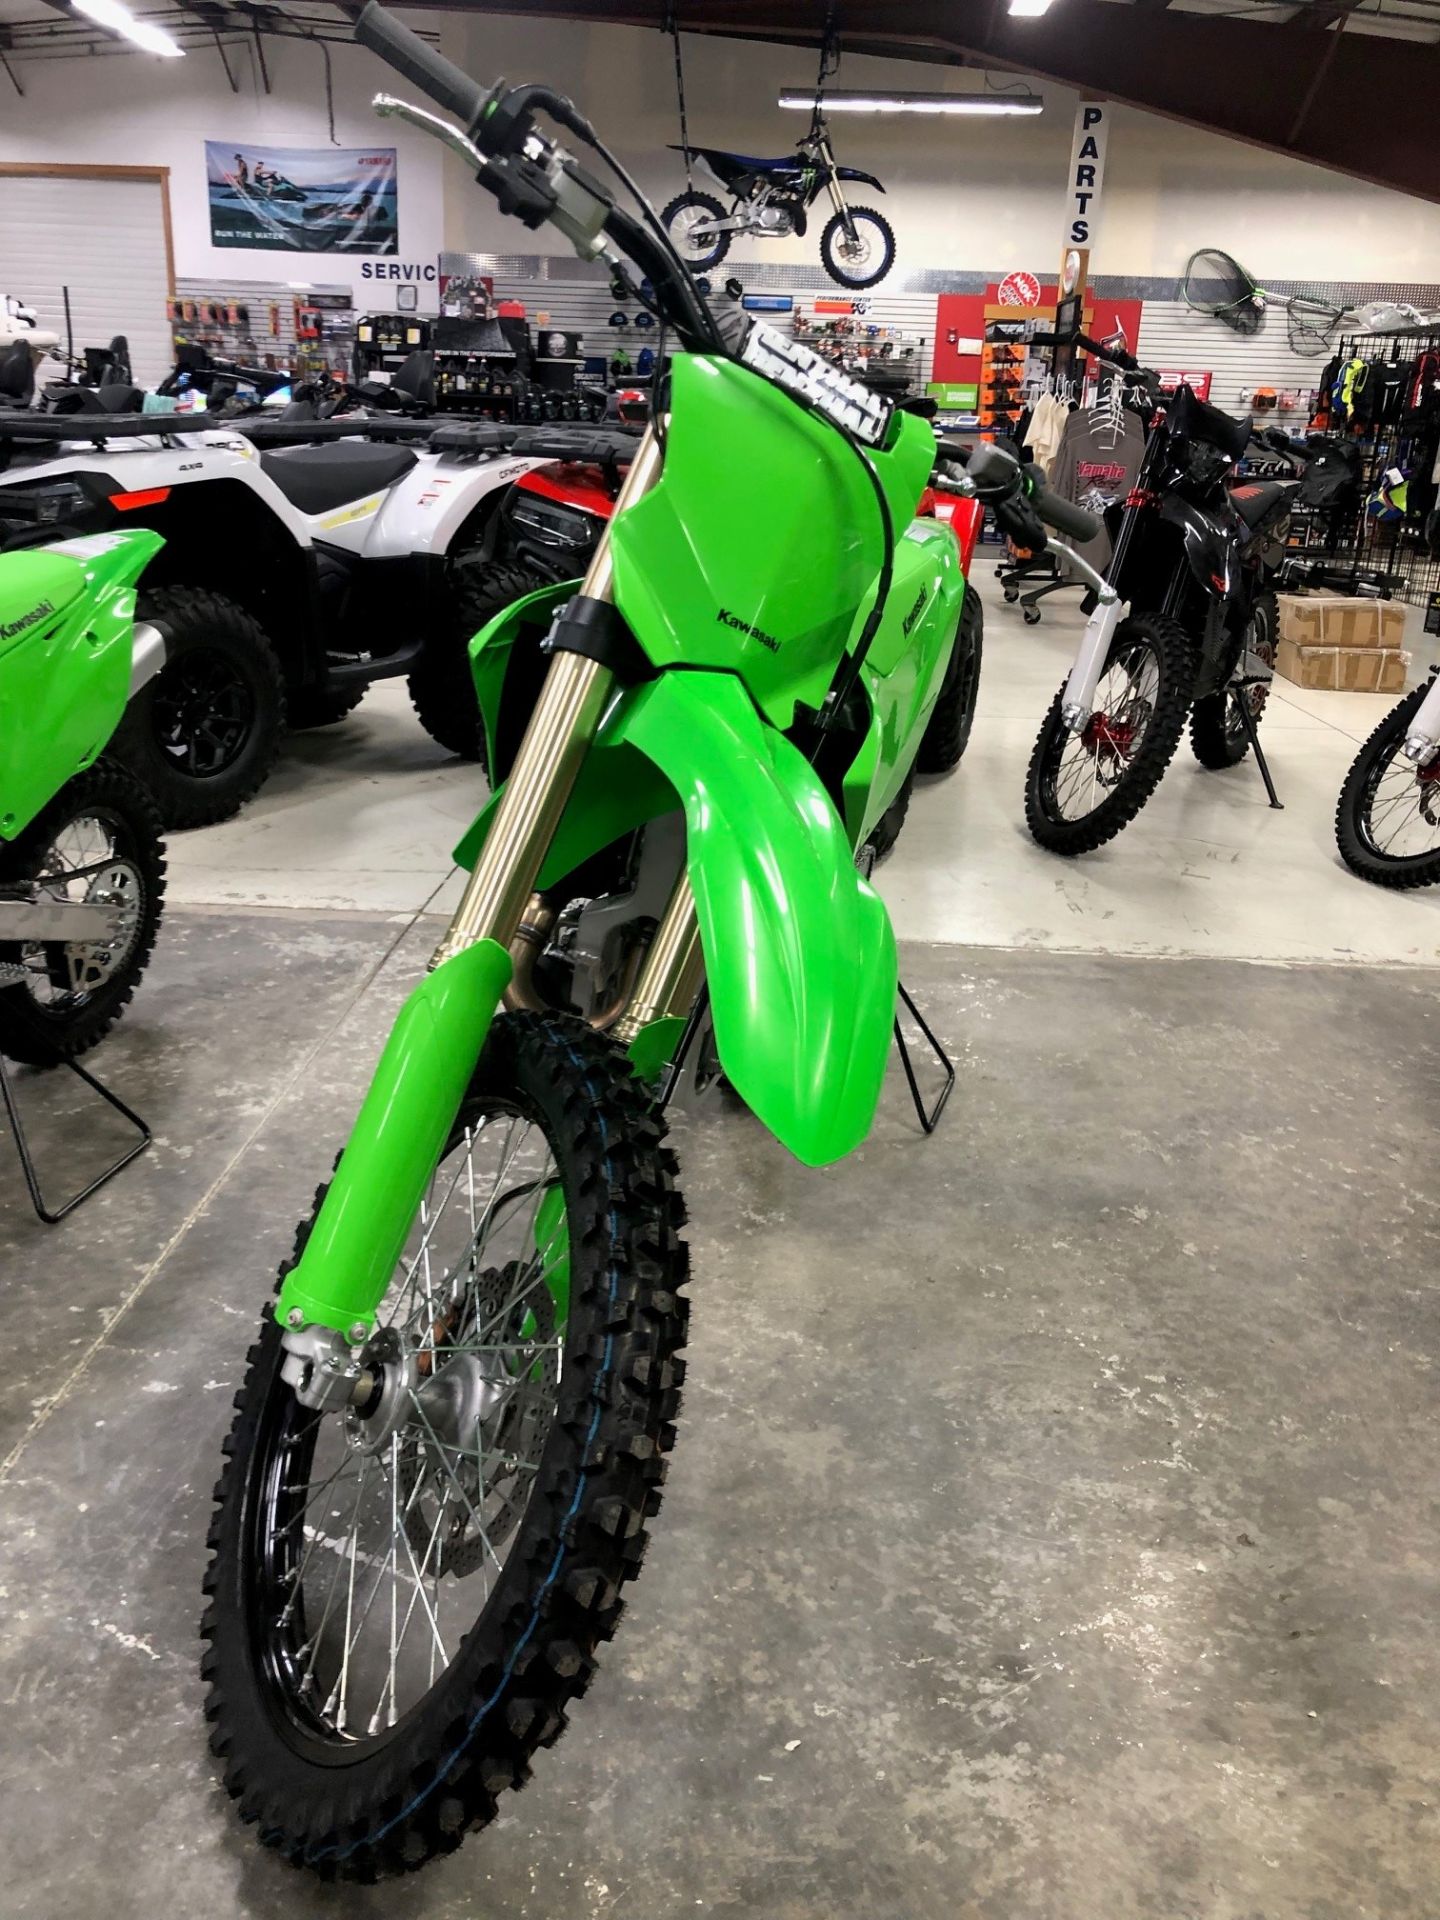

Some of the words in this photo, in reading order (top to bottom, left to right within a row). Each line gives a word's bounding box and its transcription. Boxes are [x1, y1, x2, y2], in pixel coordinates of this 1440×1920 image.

[1071, 107, 1102, 243] PARTS
[235, 230, 252, 239] THE
[255, 231, 284, 240] WATER
[361, 262, 436, 281] SERVIC
[1012, 274, 1035, 303] NGK
[1078, 460, 1127, 478] Yamaha
[0, 599, 56, 640] Kawasaki
[717, 608, 782, 653] Kawasaki
